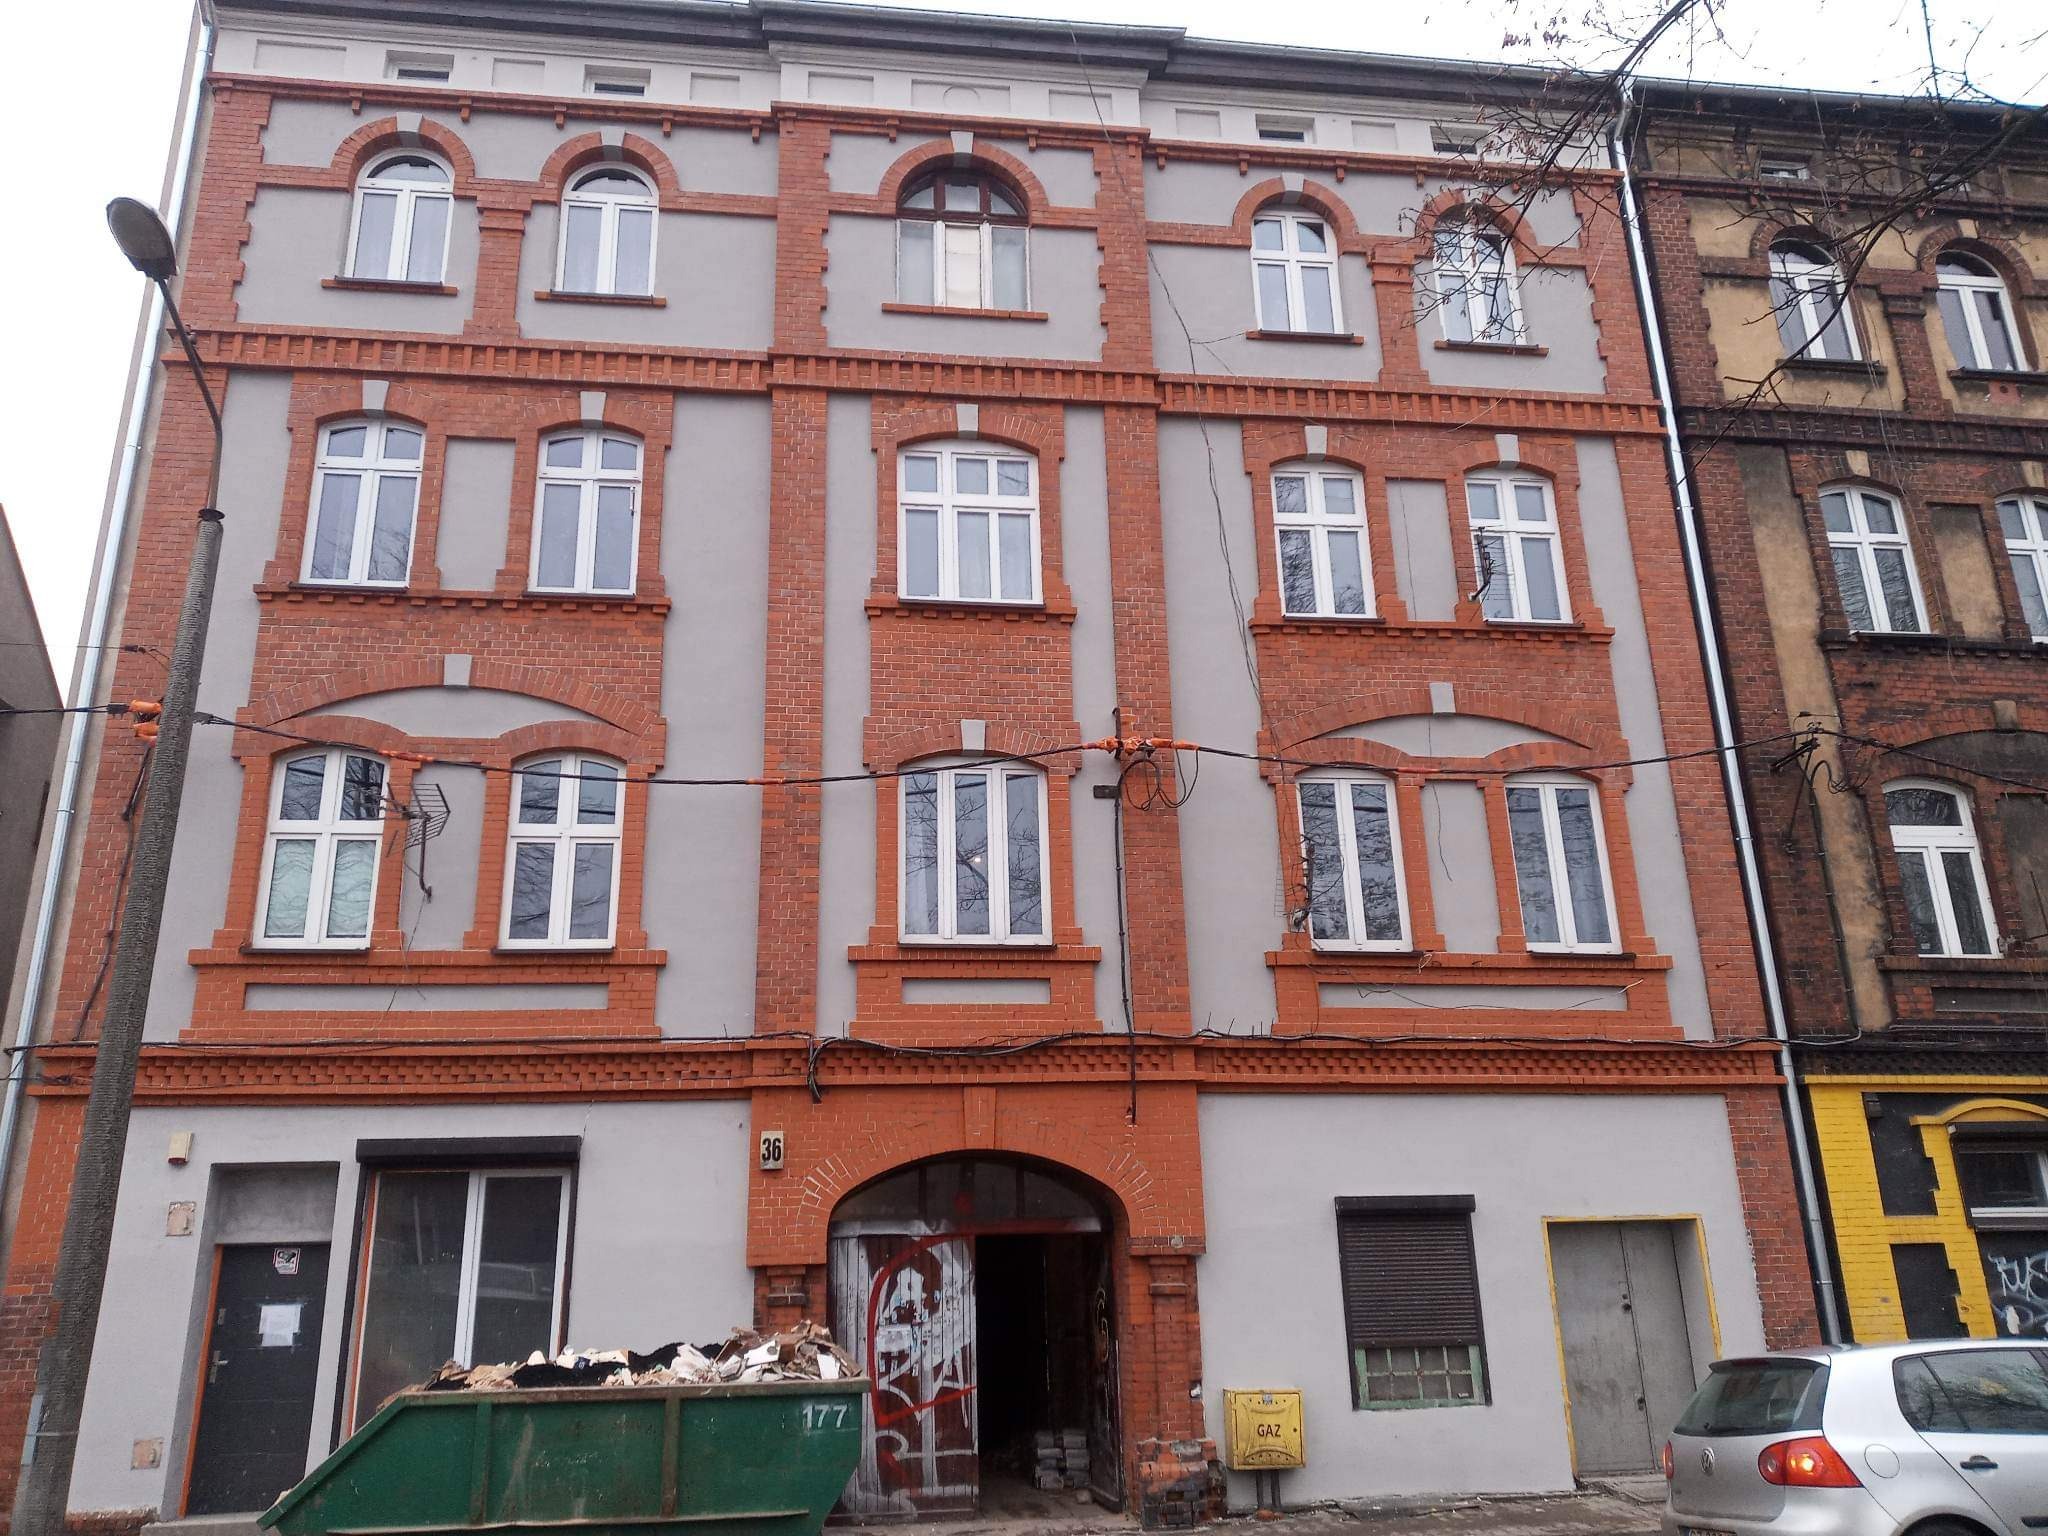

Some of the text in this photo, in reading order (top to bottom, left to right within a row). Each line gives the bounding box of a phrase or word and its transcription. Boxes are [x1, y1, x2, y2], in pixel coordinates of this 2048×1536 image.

[761, 1137, 782, 1162] 36
[802, 1404, 848, 1429] 177
[1257, 1424, 1281, 1437] GAZ
